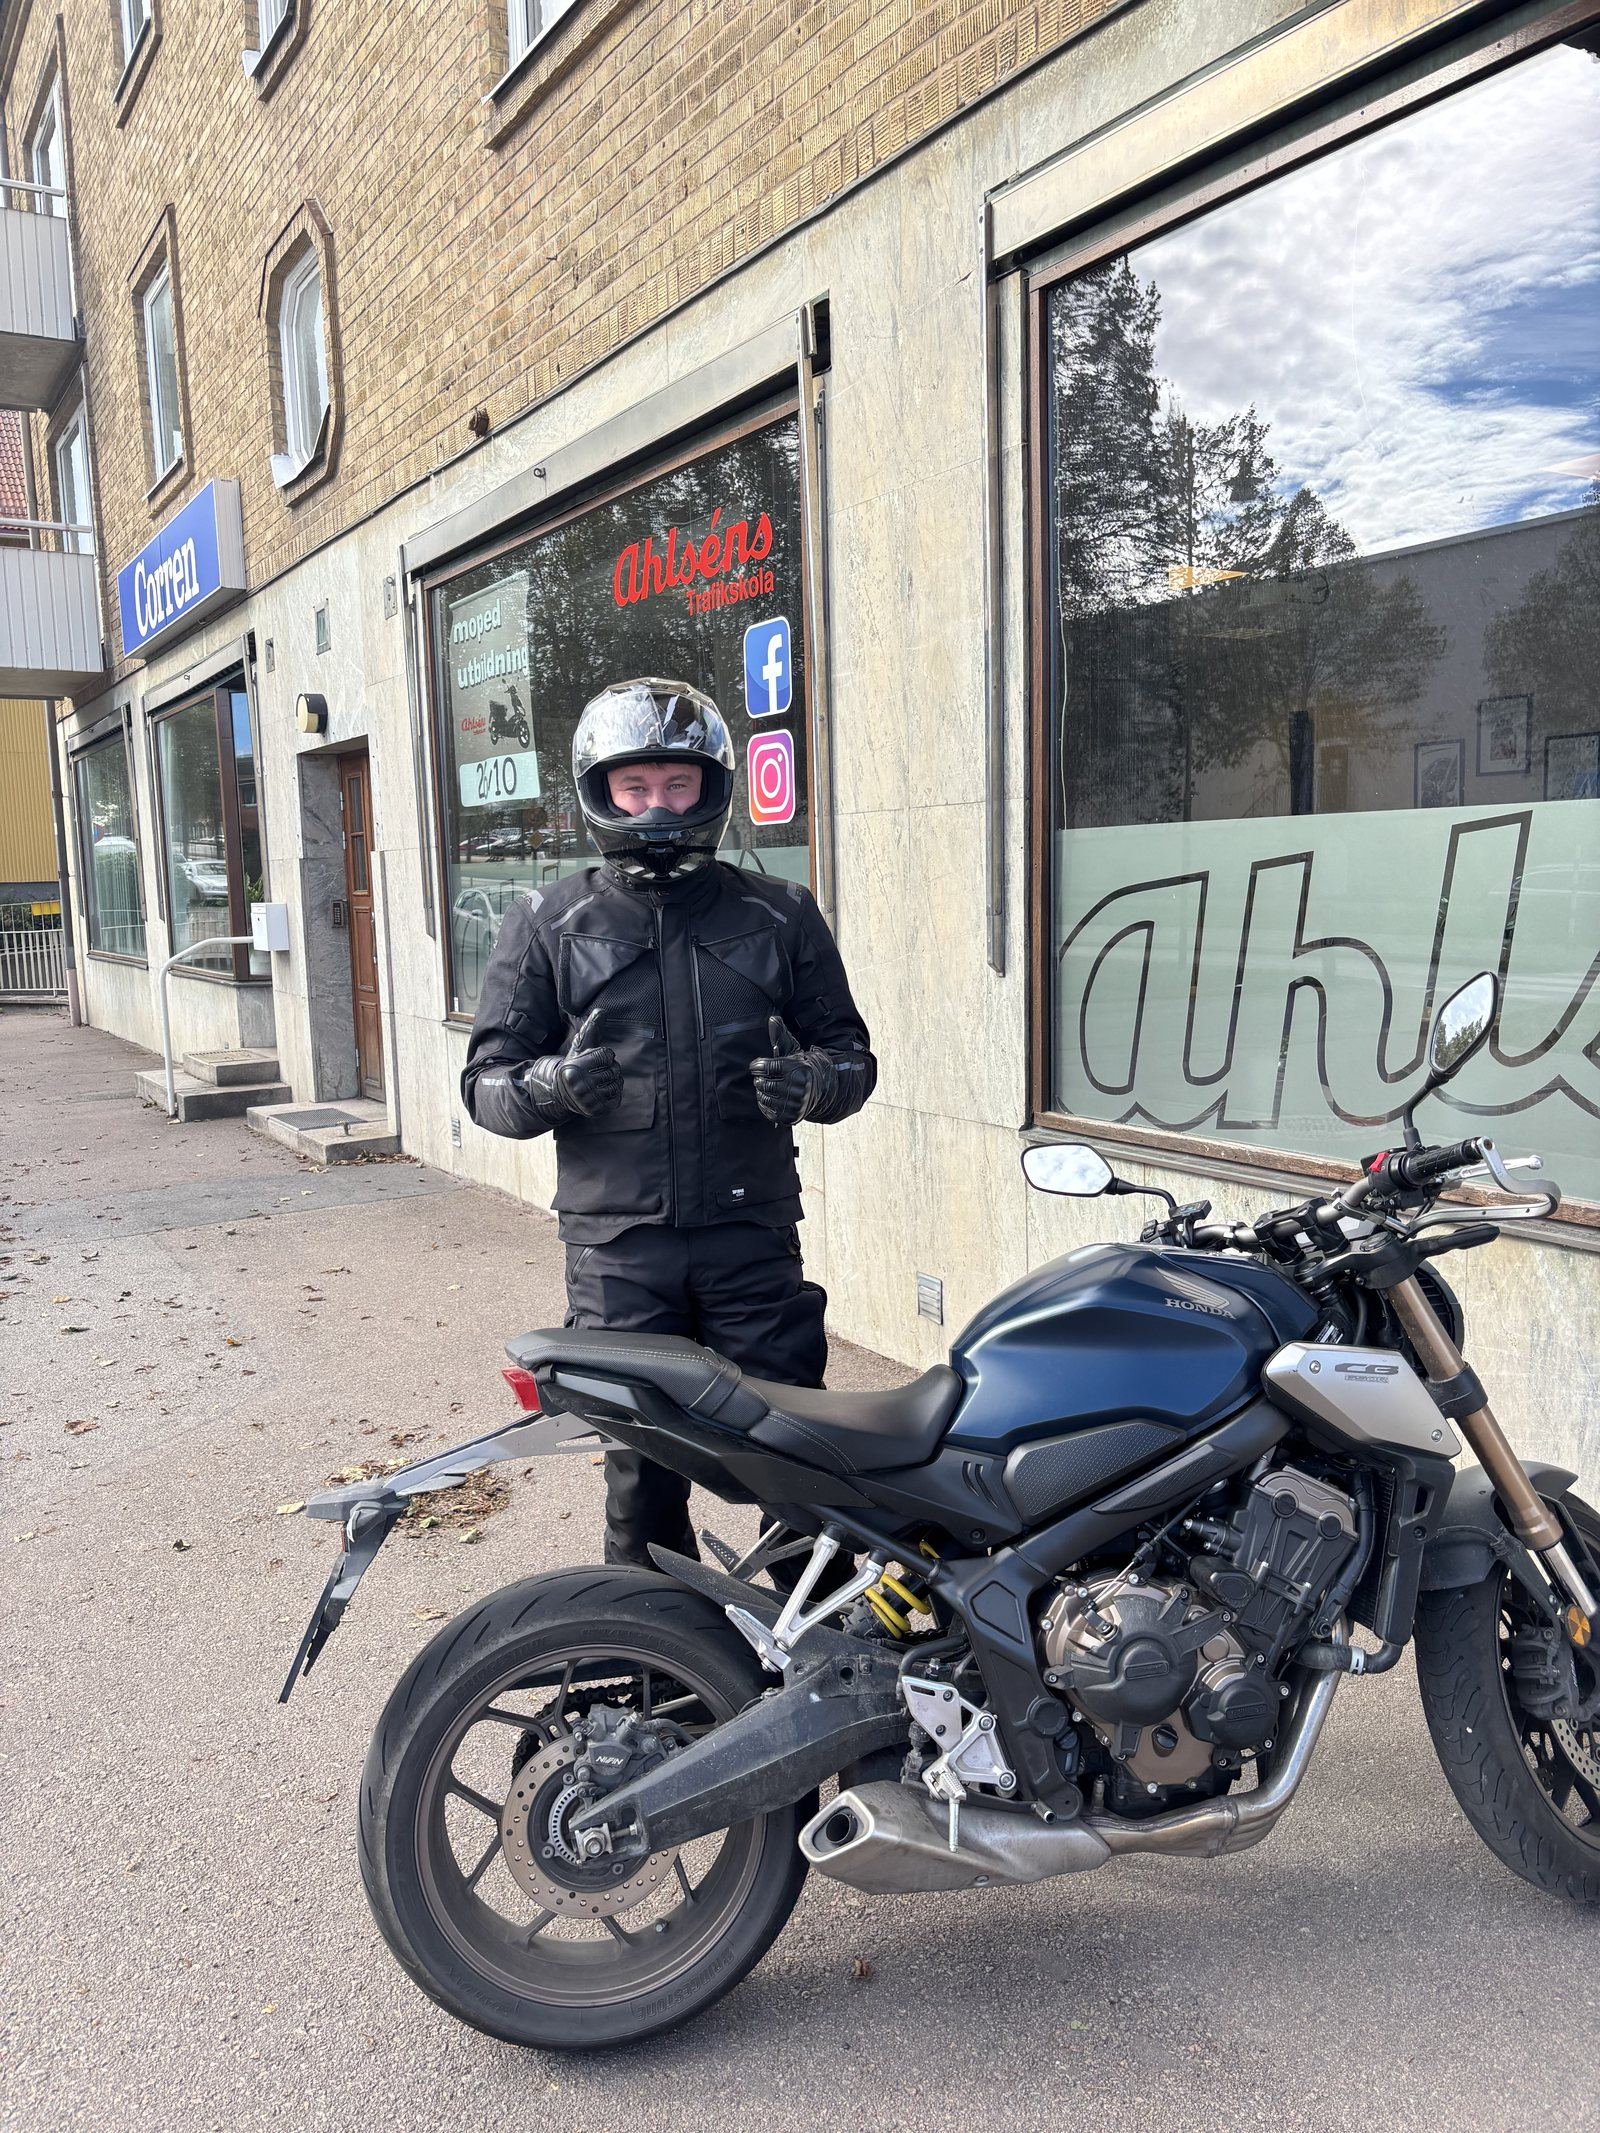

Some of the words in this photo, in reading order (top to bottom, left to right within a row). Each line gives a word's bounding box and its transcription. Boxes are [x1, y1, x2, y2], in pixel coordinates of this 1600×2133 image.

[134, 537, 200, 637] Corren
[685, 567, 775, 617] Trafikskola
[453, 598, 502, 644] moped
[457, 643, 529, 690] utbildning
[1164, 1298, 1236, 1320] HONDA
